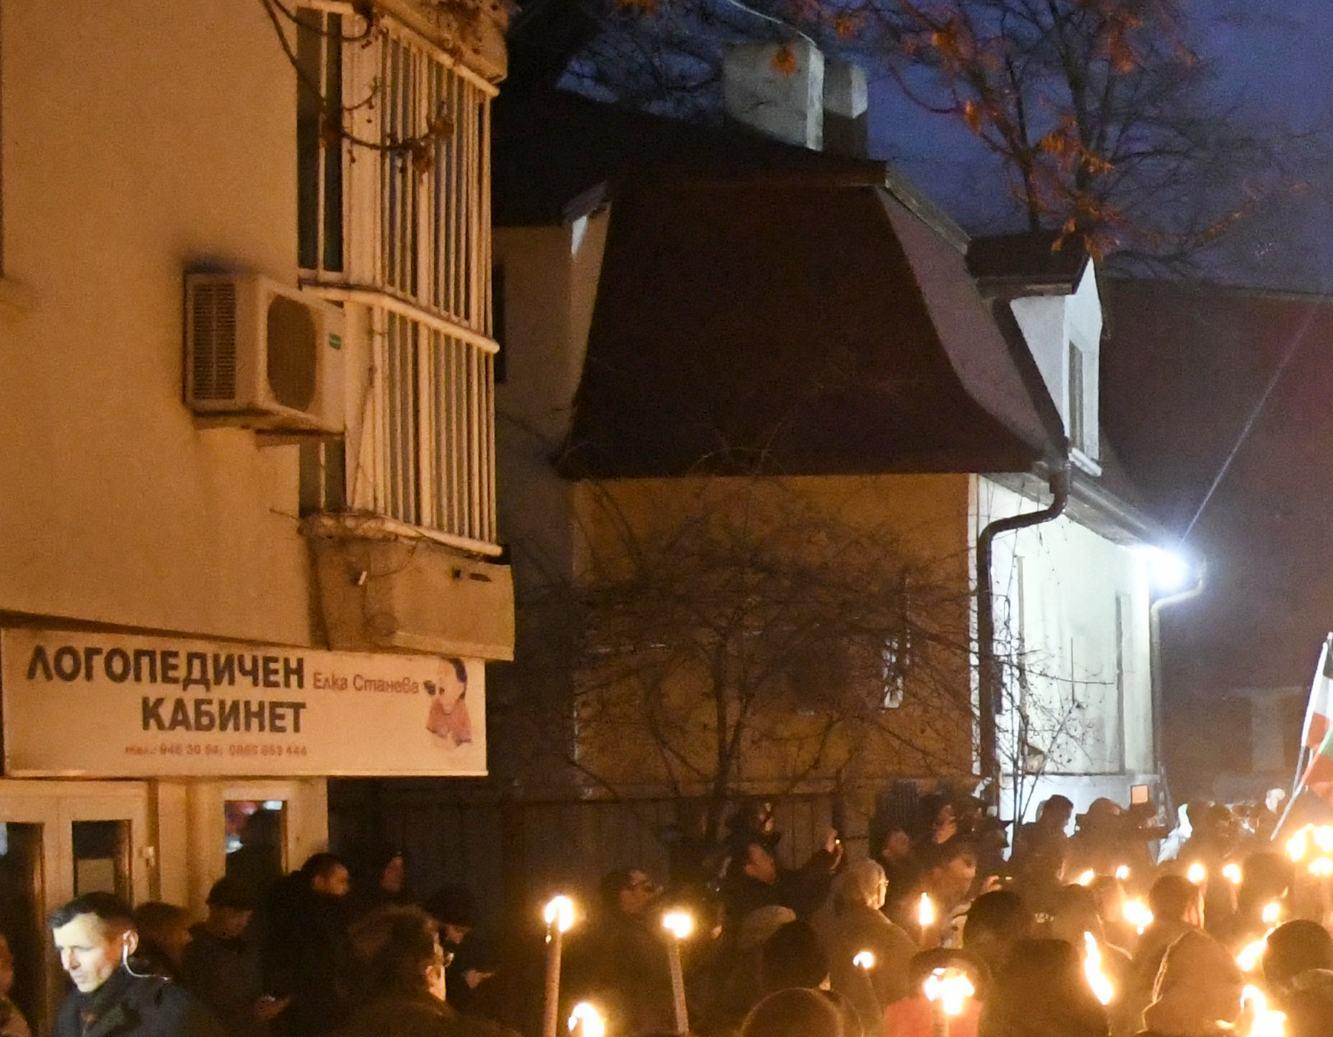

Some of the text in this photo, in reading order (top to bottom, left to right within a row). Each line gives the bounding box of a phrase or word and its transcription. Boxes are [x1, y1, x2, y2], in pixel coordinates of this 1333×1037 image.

[27, 645, 305, 692] ЛОГОПЕДИЧЕН
[313, 671, 420, 694] Елка Станева
[141, 696, 306, 733] КАБИНЕТ
